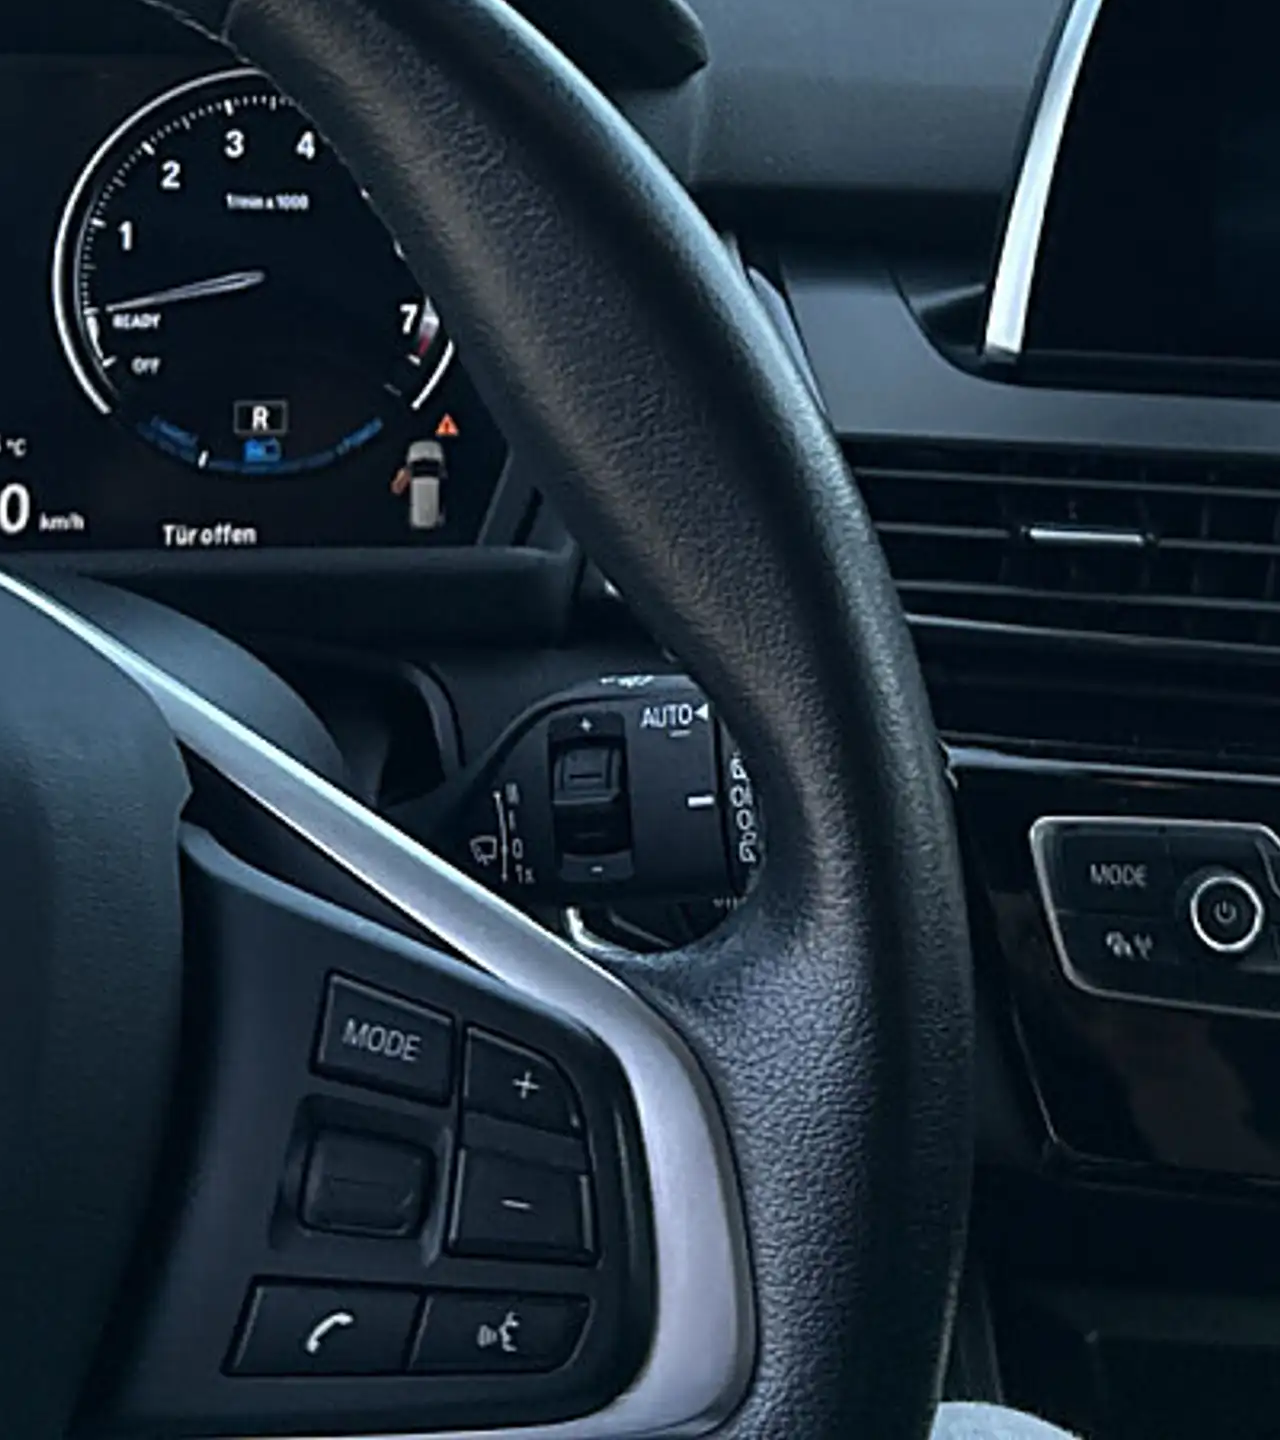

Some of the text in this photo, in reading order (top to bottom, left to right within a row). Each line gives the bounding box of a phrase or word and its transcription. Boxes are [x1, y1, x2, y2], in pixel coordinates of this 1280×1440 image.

[225, 128, 245, 158] 3
[296, 131, 315, 160] 4
[160, 162, 181, 189] 2
[118, 221, 132, 250] 1
[400, 304, 418, 334] 7
[252, 405, 270, 431] R
[38, 512, 85, 532] km/h
[199, 521, 257, 546] offen
[640, 703, 692, 728] AUTO
[1090, 863, 1148, 888] MODE
[342, 1018, 421, 1062] MODE
